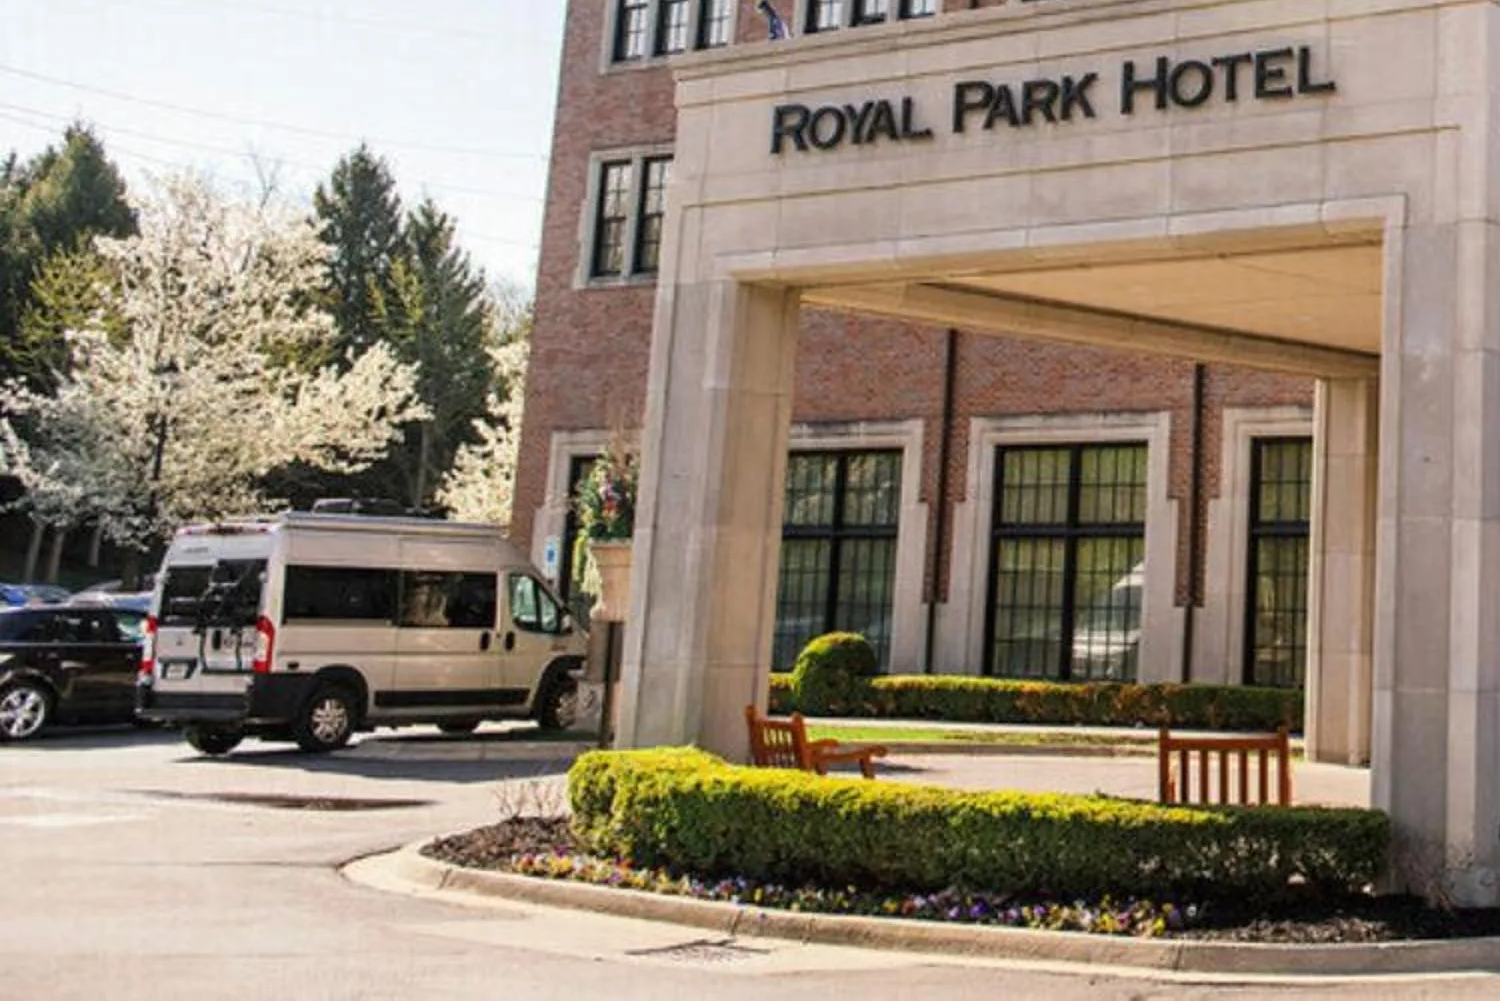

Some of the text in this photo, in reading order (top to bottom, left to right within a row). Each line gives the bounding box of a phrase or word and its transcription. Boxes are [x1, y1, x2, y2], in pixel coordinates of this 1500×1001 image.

[770, 46, 1336, 155] ROYAL PARK HOTEL
